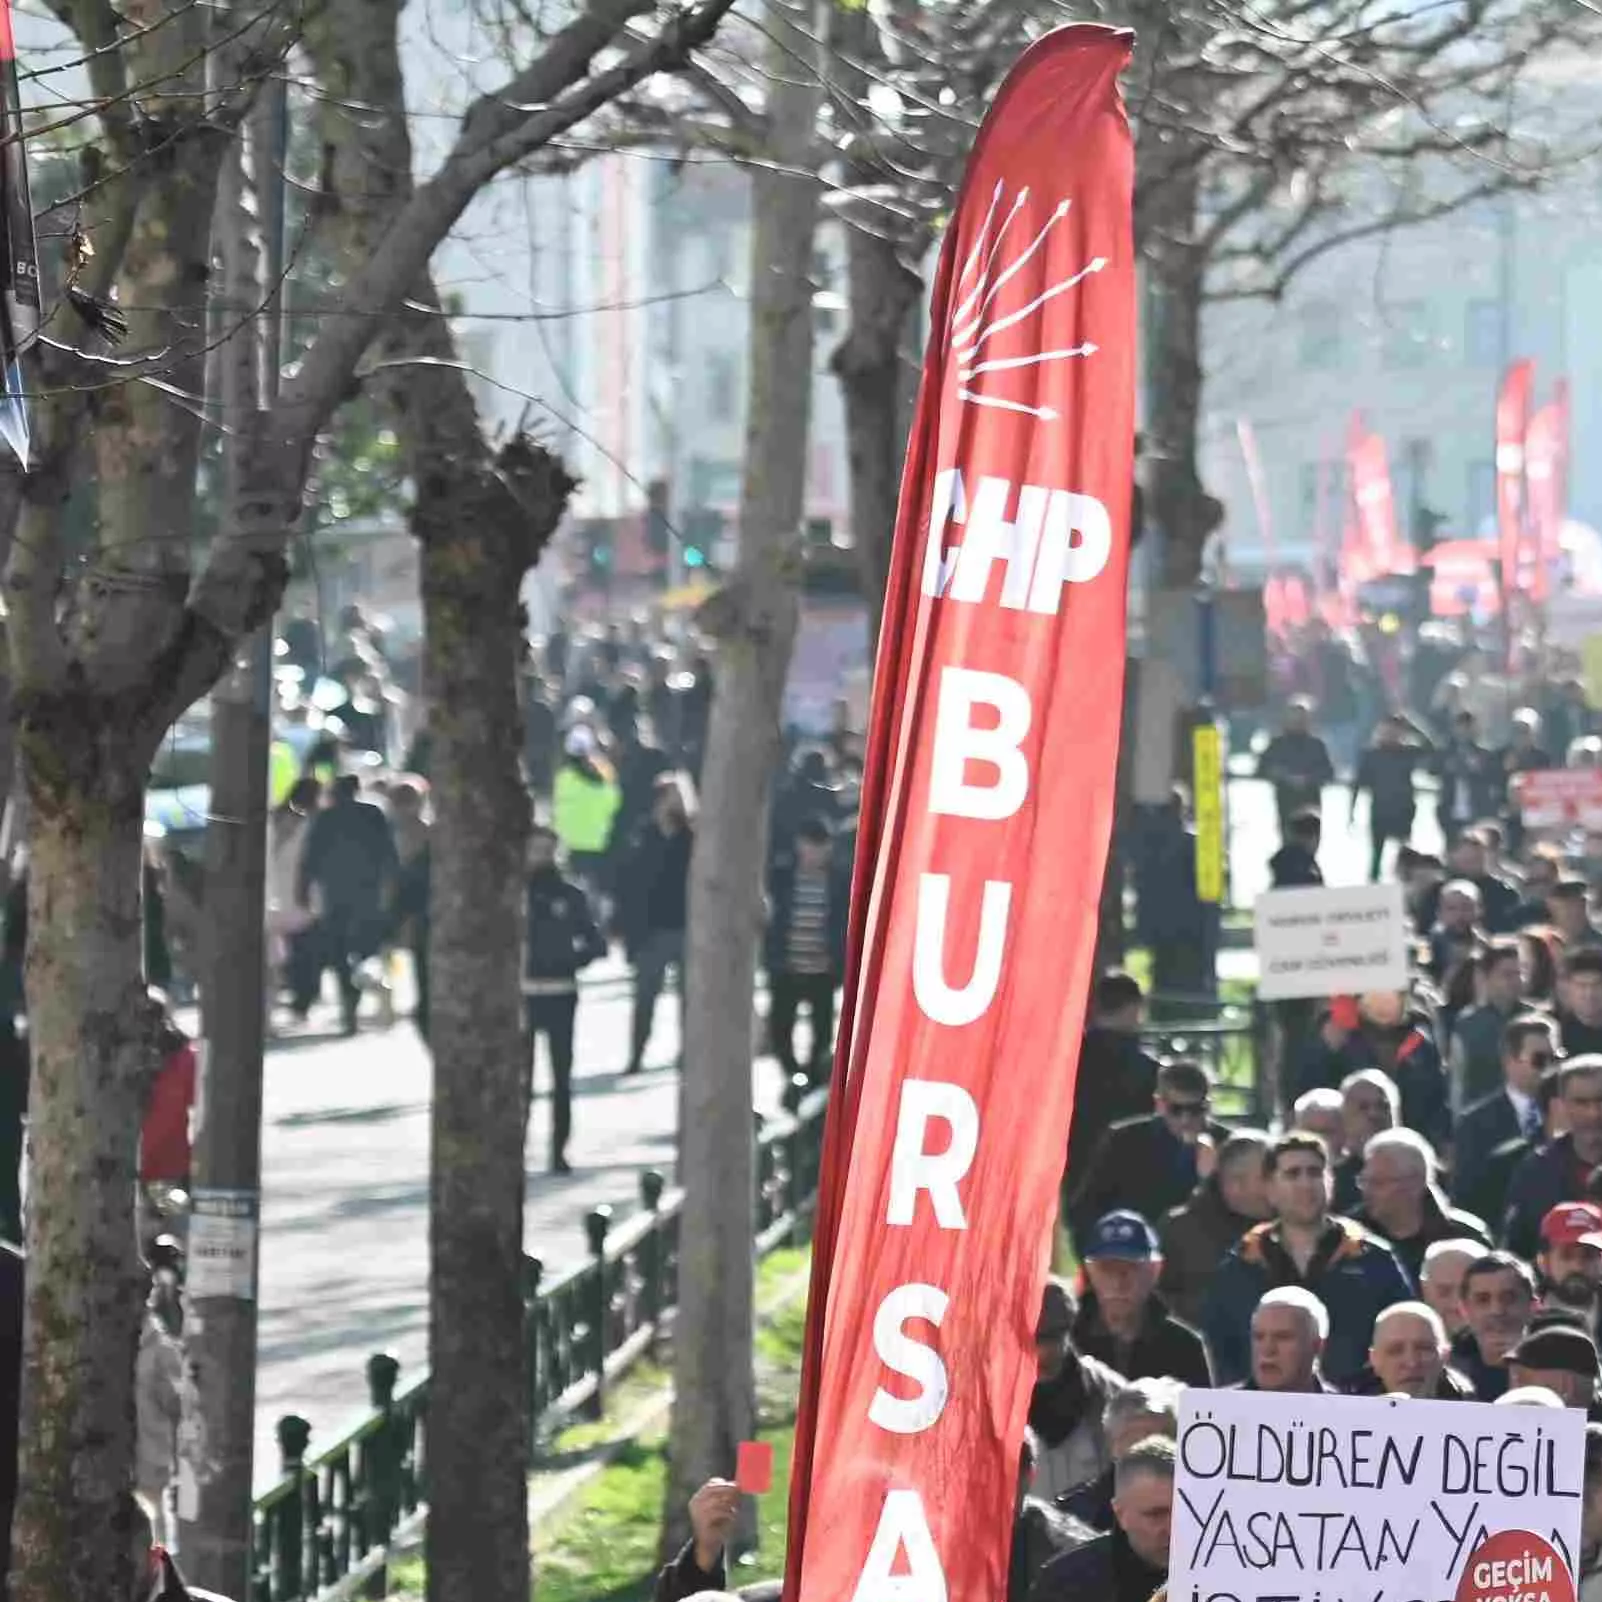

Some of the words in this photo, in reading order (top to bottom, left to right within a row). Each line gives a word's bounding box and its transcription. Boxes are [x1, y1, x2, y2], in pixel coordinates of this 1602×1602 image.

[922, 467, 1111, 616] CHP
[1180, 1411, 1424, 1490] ÖLDÜREN
[1441, 1427, 1581, 1498] DEĞİL
[1473, 1550, 1553, 1596] GEÇİM
